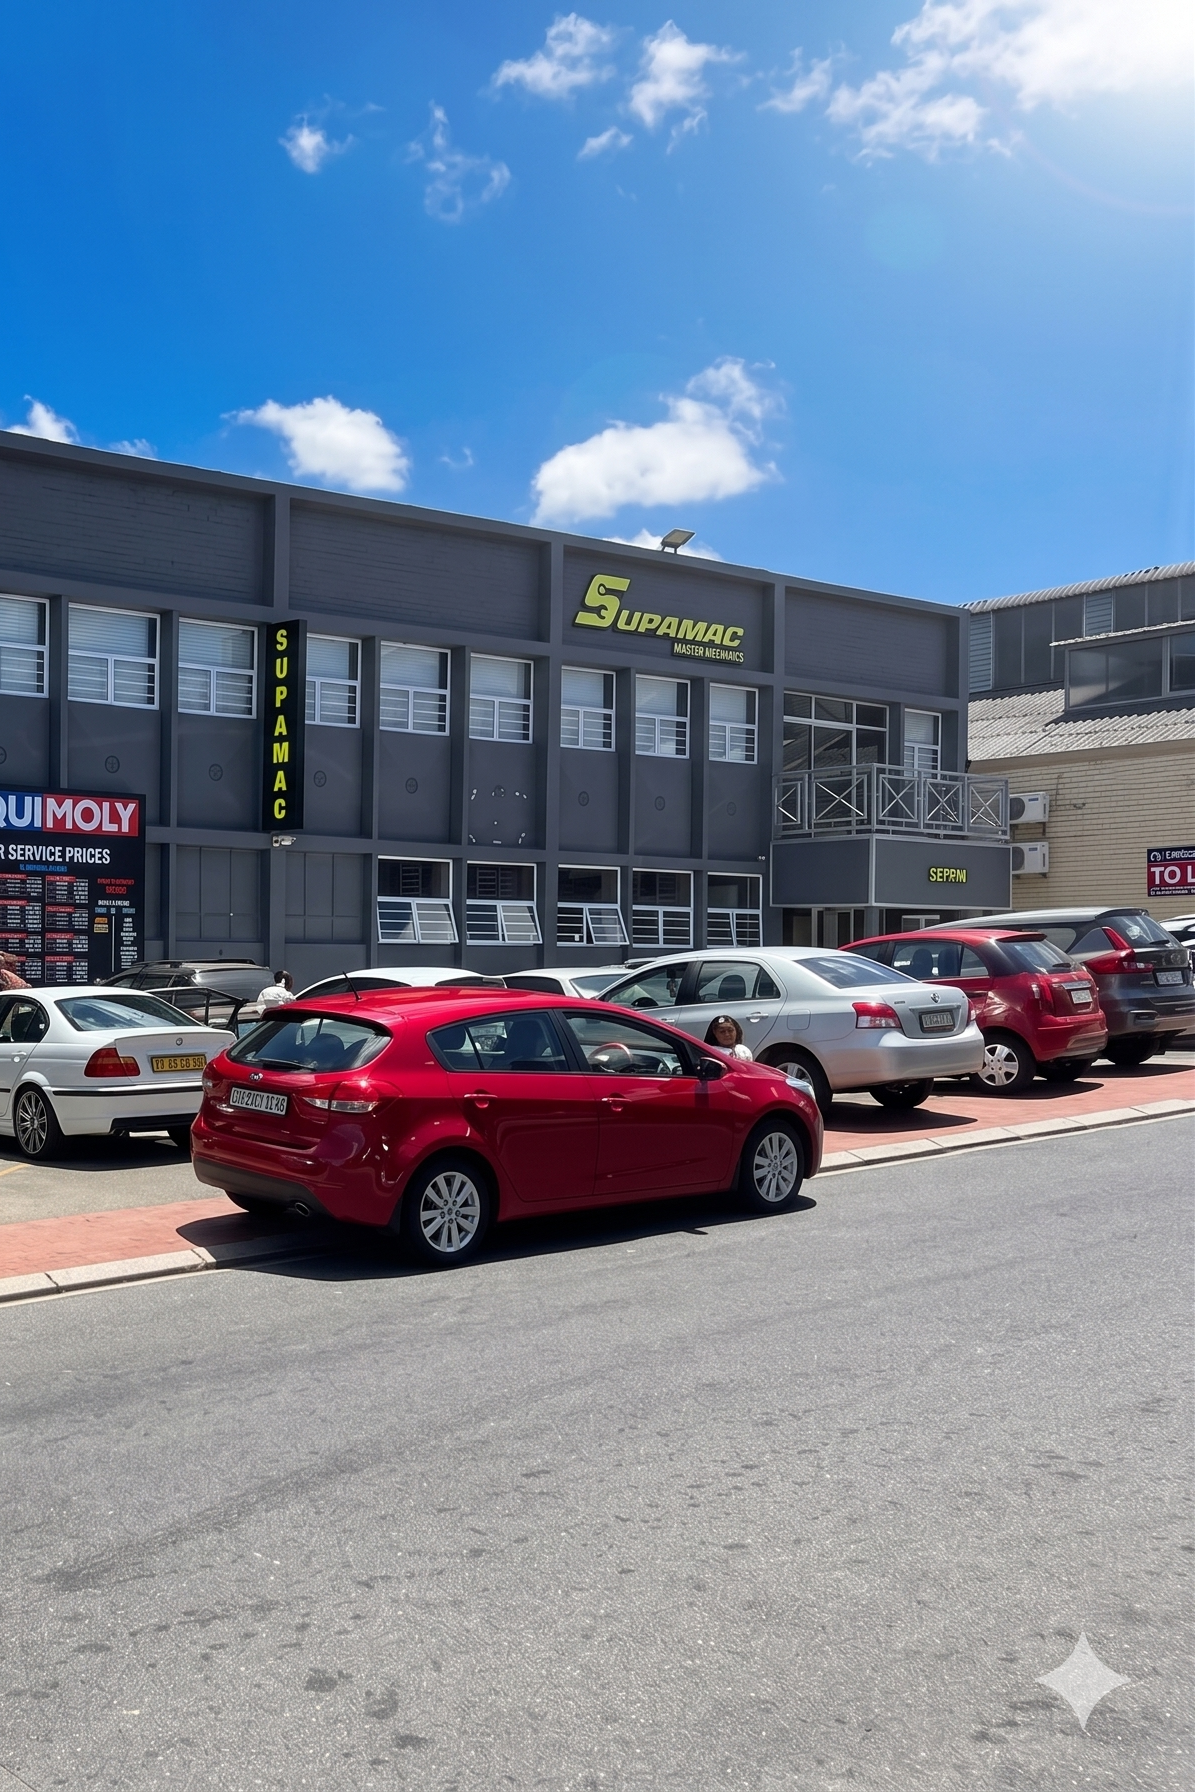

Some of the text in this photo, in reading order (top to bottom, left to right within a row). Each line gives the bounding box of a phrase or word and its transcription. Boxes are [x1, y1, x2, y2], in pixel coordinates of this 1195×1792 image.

[574, 574, 744, 647] SUPAMAC
[272, 629, 289, 820] SUPAMAC
[8, 844, 63, 862] SERVICE
[65, 846, 111, 864] PRICES
[1150, 865, 1181, 884] TO
